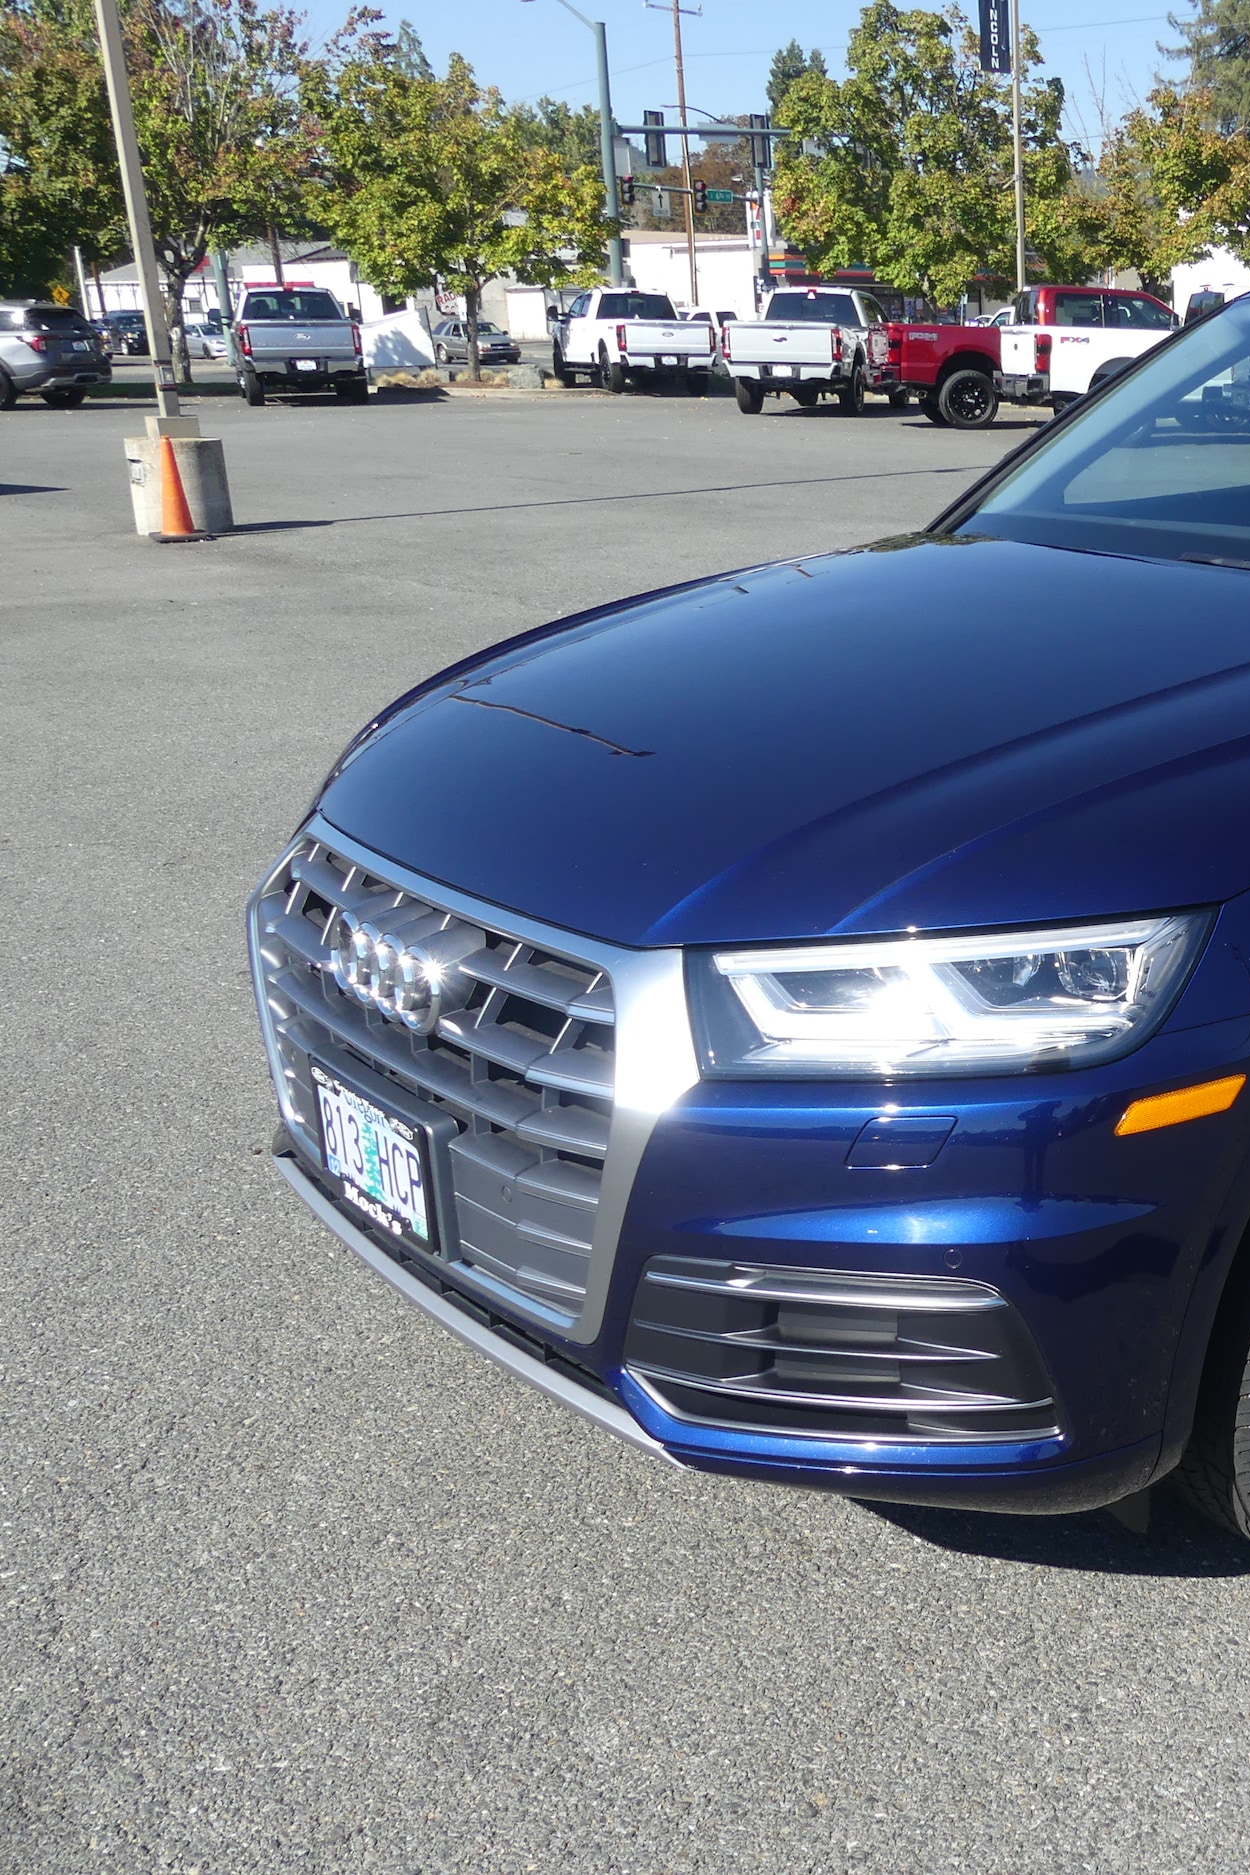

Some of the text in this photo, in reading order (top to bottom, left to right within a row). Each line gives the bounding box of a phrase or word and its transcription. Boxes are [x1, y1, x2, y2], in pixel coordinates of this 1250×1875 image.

[1060, 336, 1090, 345] FX4
[323, 1096, 364, 1175] 813
[375, 1130, 422, 1213] HCP
[344, 1181, 403, 1236] Mock's
